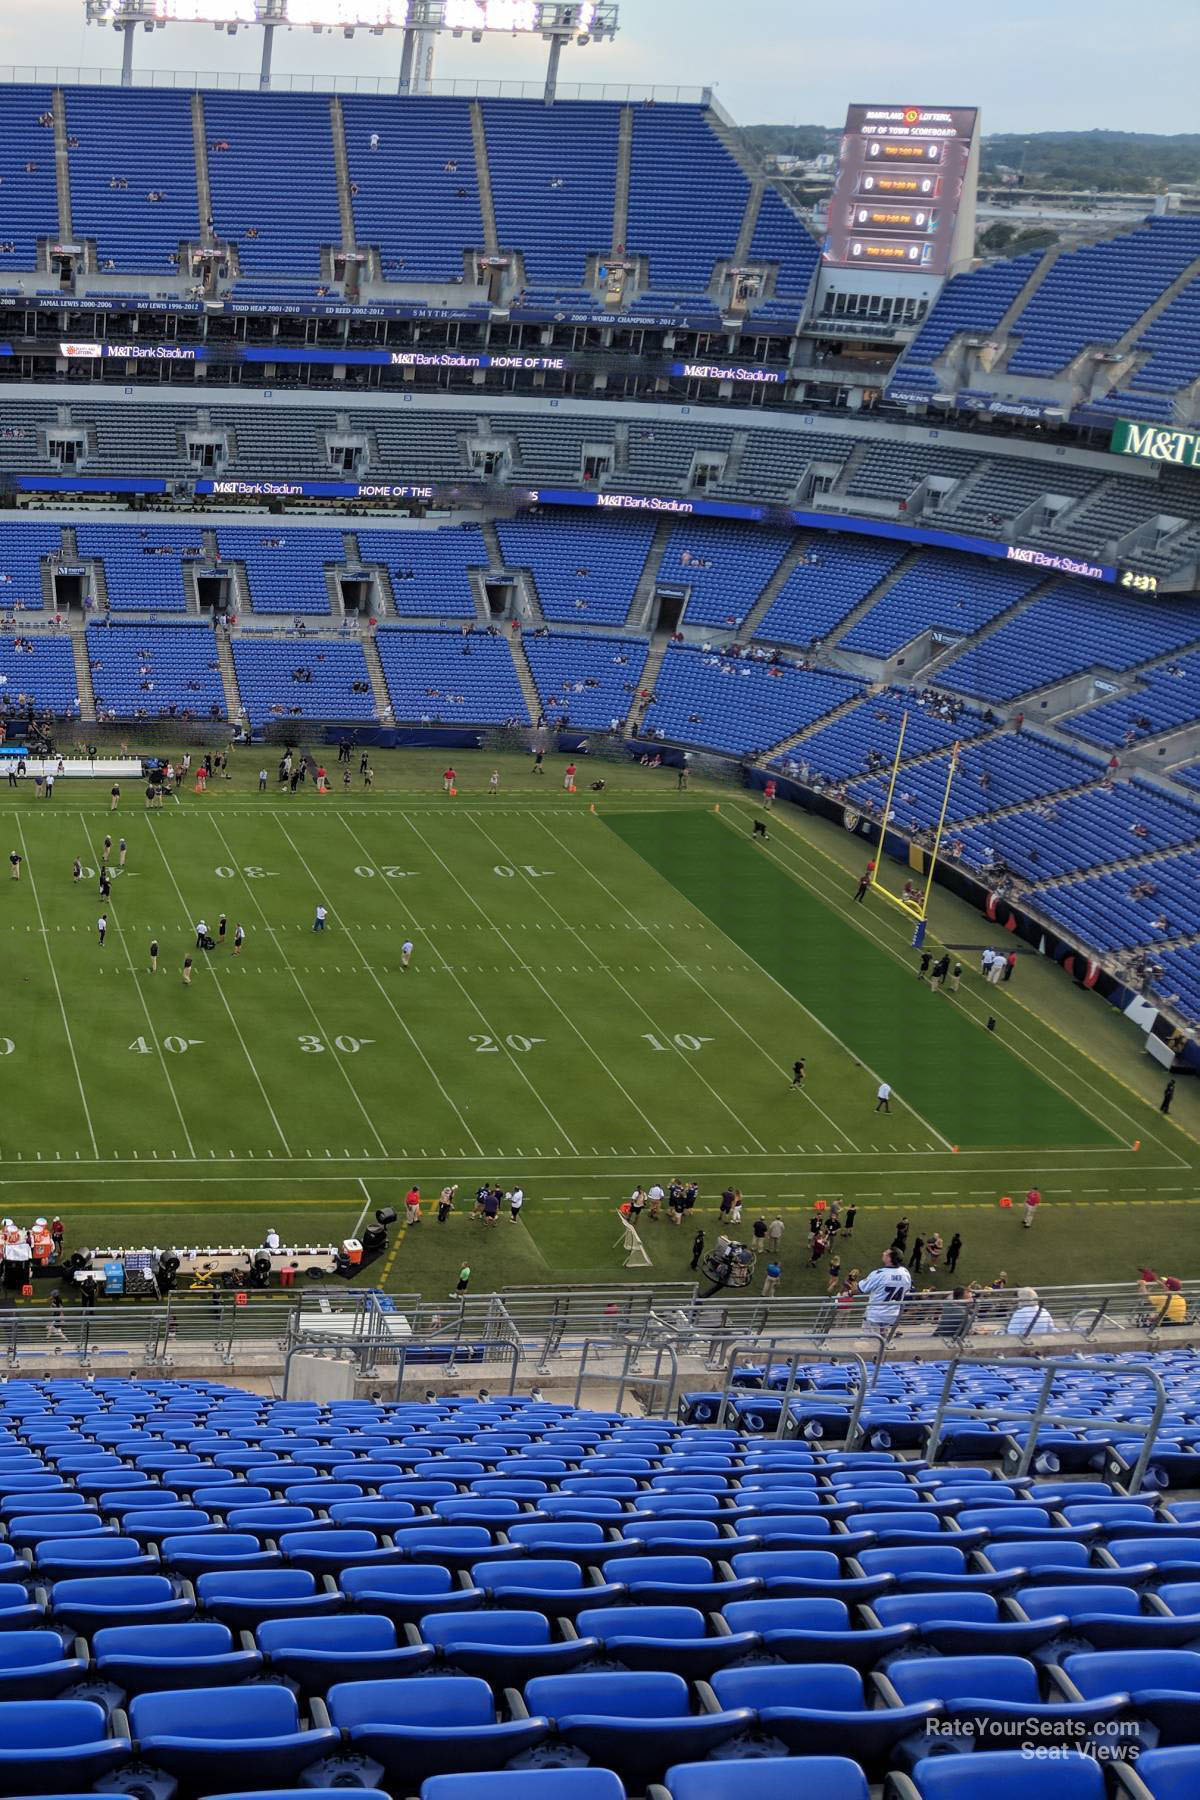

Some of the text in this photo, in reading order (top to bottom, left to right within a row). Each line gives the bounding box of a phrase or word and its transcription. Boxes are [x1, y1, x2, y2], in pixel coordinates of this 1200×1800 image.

[866, 111, 904, 120] MARYLAND
[861, 126, 957, 137] OUT OF TOWN SCOREBOARD
[871, 143, 938, 158] 0 0
[864, 177, 931, 192] 0 0
[858, 210, 925, 226] 0 0
[852, 243, 919, 259] 0 0
[352, 307, 385, 315] 2002-2012
[617, 316, 655, 324] CHAMPIONS
[659, 318, 676, 326] 2012
[108, 346, 195, 359] M&T Bank Stadium
[391, 353, 480, 366] M&T Bank Stadium
[490, 357, 563, 369] HOME OF THE
[684, 365, 778, 382] M&T Bank Stadium
[890, 392, 929, 402] RAVENS
[1123, 424, 1194, 464] M&T
[213, 482, 303, 494] M&T Bank Stadium
[358, 486, 432, 497] HOME OF THE
[597, 494, 693, 513] M&T Bank Stadium
[1007, 546, 1103, 579] M&T Bank Stadium
[214, 866, 267, 879] 30
[353, 865, 406, 878] 20
[493, 865, 544, 877] 10
[127, 1036, 188, 1054] 40
[297, 1035, 361, 1053] 30
[468, 1034, 532, 1053] 20
[641, 1033, 702, 1051] 10
[884, 1286, 904, 1302] 74
